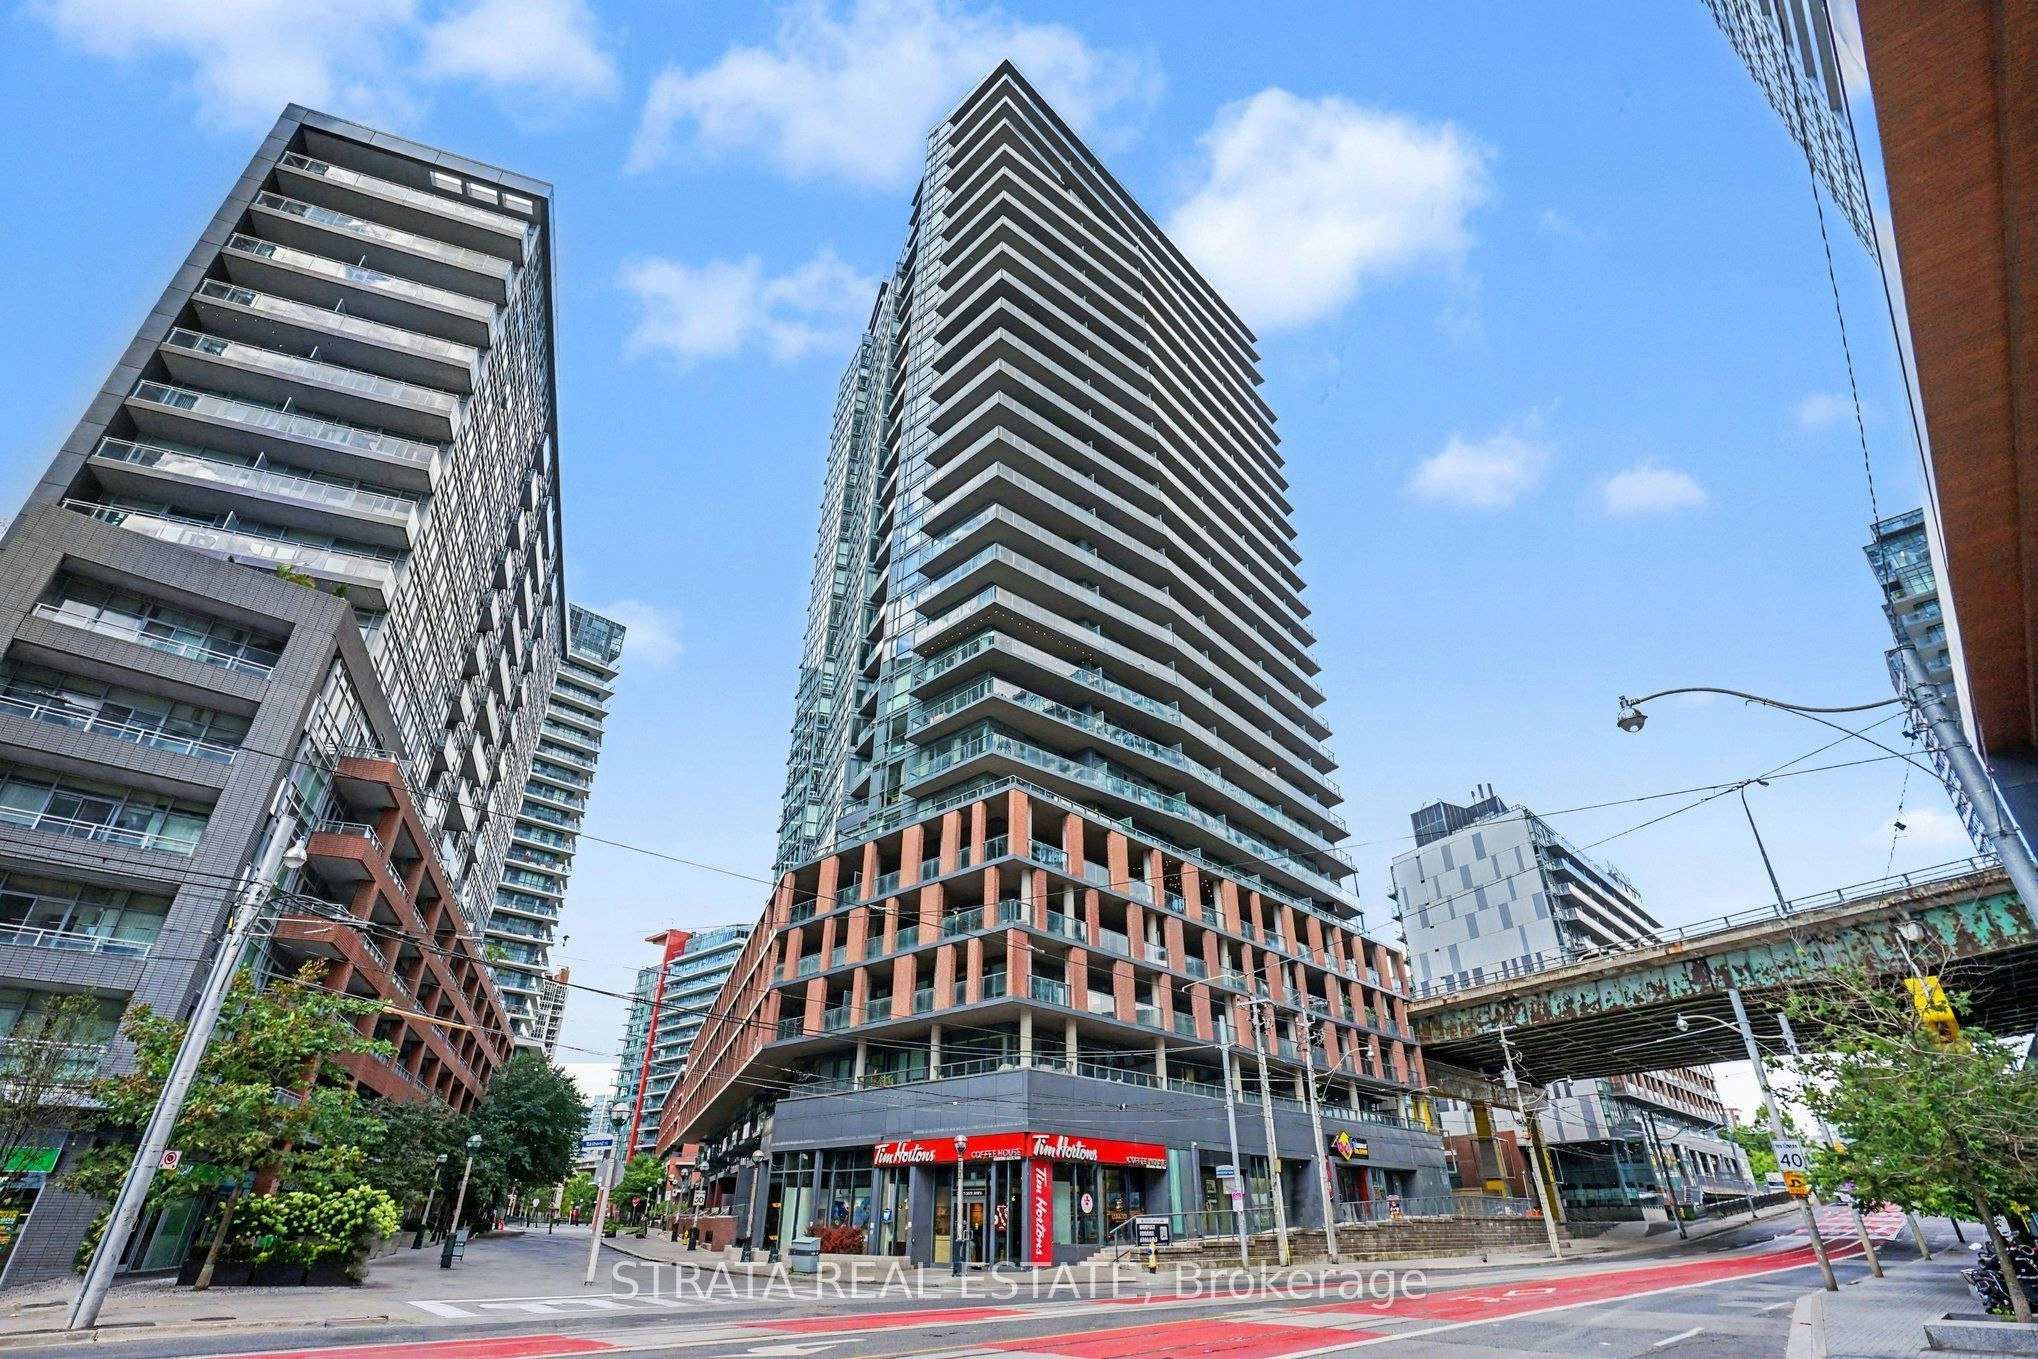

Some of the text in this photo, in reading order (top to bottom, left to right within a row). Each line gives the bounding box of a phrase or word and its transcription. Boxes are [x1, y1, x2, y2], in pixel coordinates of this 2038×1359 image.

[874, 1141, 936, 1165] Tim Hortons
[1032, 1134, 1098, 1161] Tim Hortons
[1780, 1153, 1803, 1168] 40
[1035, 1167, 1048, 1256] Tim Hortons
